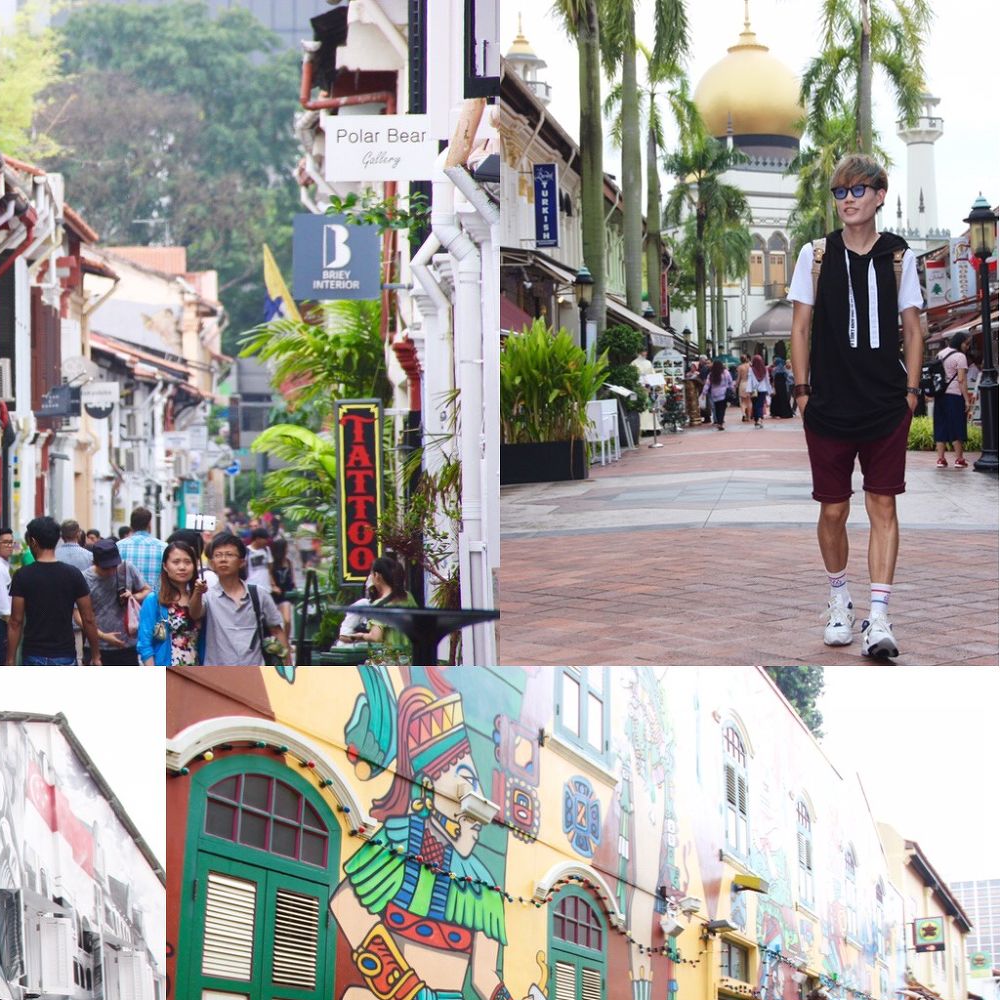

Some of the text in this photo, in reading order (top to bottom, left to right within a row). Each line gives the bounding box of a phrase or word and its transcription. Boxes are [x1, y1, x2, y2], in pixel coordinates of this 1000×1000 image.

[336, 128, 427, 144] Polar Bear
[361, 150, 401, 169] Gallery
[541, 181, 550, 240] TURKISH
[322, 270, 352, 279] BRIEY
[312, 279, 360, 290] INTERIOR
[339, 414, 378, 571] TATTOO
